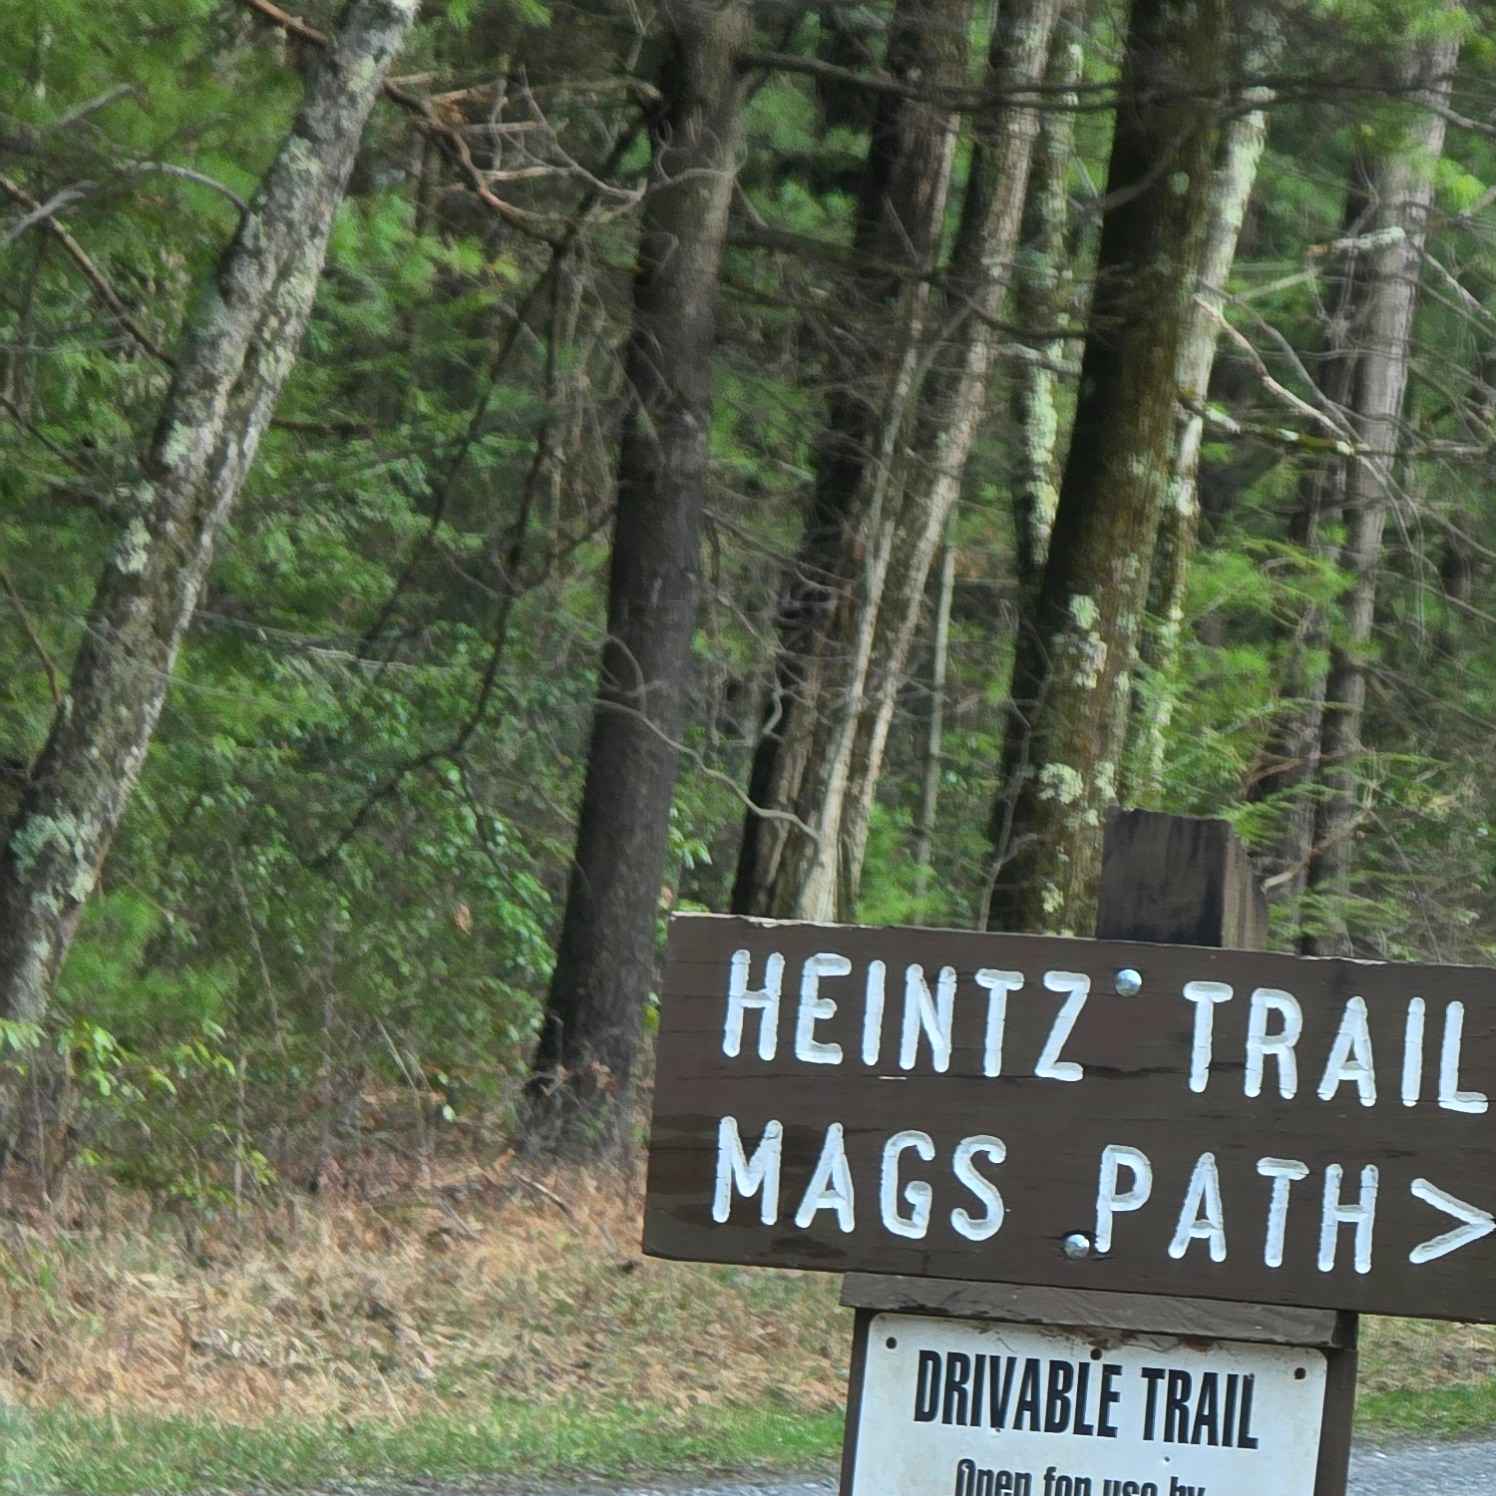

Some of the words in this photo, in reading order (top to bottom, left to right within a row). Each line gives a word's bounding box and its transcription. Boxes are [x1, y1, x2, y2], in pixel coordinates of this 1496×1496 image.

[722, 948, 1091, 1082] HEINTZ
[1183, 981, 1489, 1114] TRAIL
[711, 1116, 1008, 1242] MAGS
[1095, 1145, 1379, 1273] PATH
[913, 1349, 1123, 1438] DRIVABLE
[1141, 1366, 1259, 1450] TRAIL
